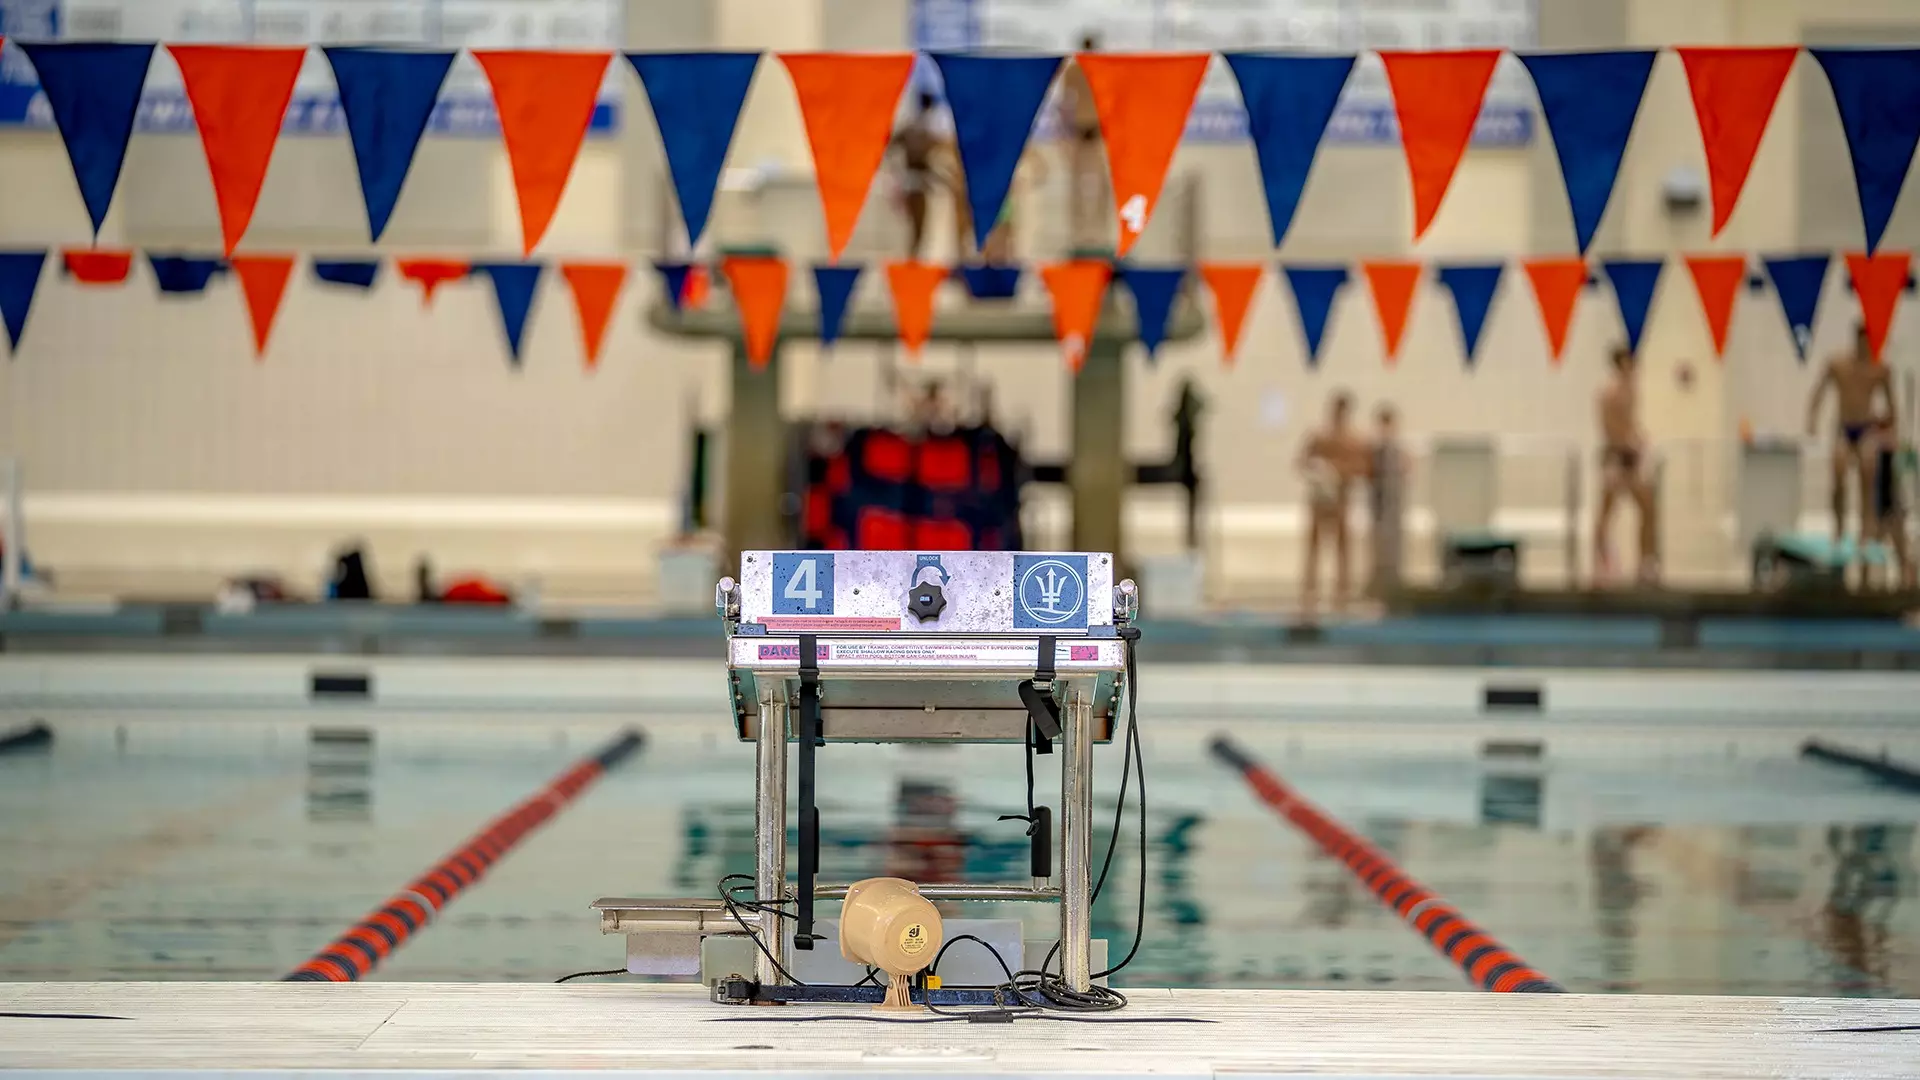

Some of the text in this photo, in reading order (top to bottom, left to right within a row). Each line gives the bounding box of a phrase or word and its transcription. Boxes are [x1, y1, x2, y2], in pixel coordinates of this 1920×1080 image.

[1119, 194, 1148, 233] 4
[784, 559, 823, 608] 4
[760, 645, 826, 656] DANGR!
